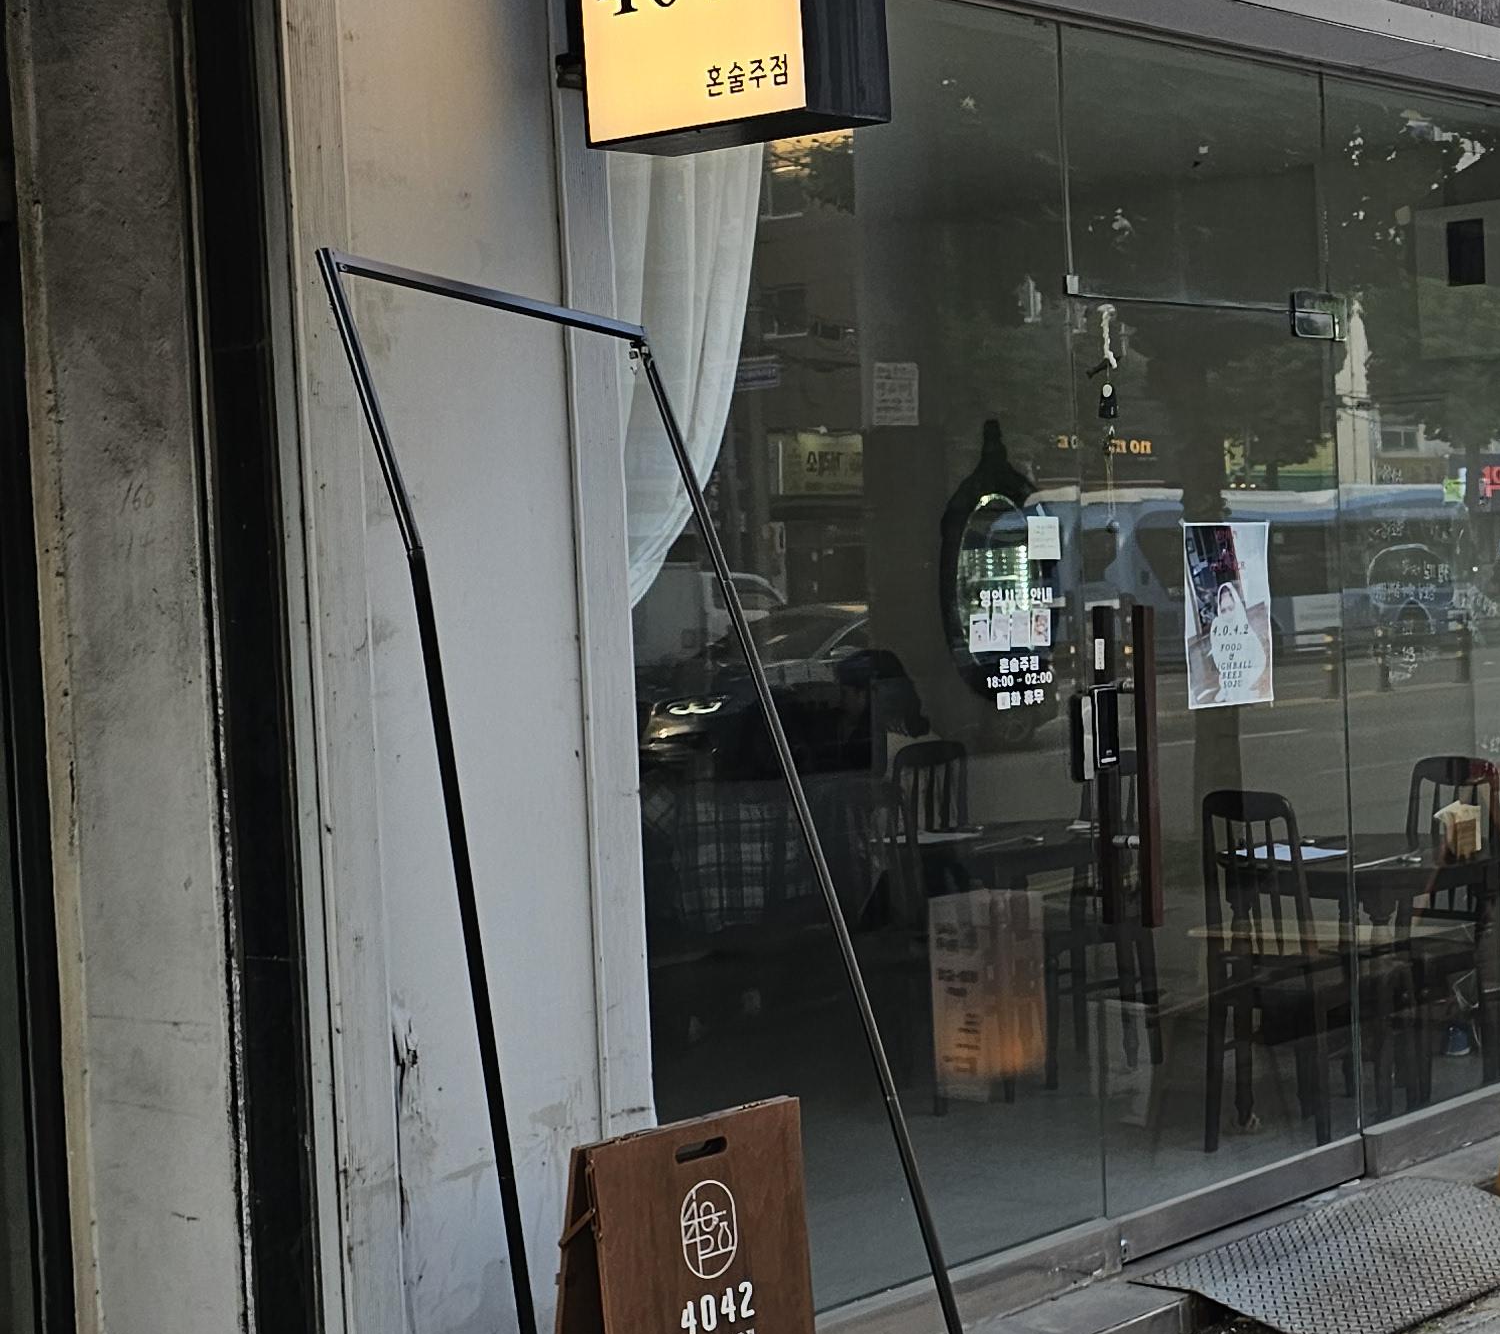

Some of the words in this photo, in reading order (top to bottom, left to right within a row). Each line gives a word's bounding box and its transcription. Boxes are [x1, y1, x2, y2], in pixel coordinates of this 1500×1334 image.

[705, 54, 789, 98] 혼술주점
[1030, 586, 1053, 605] 안내
[1219, 642, 1243, 652] FOOD
[999, 655, 1040, 674] 혼술주점
[986, 674, 1014, 689] 18:00
[1024, 671, 1053, 685] 02:00
[1023, 688, 1045, 706] 휴무
